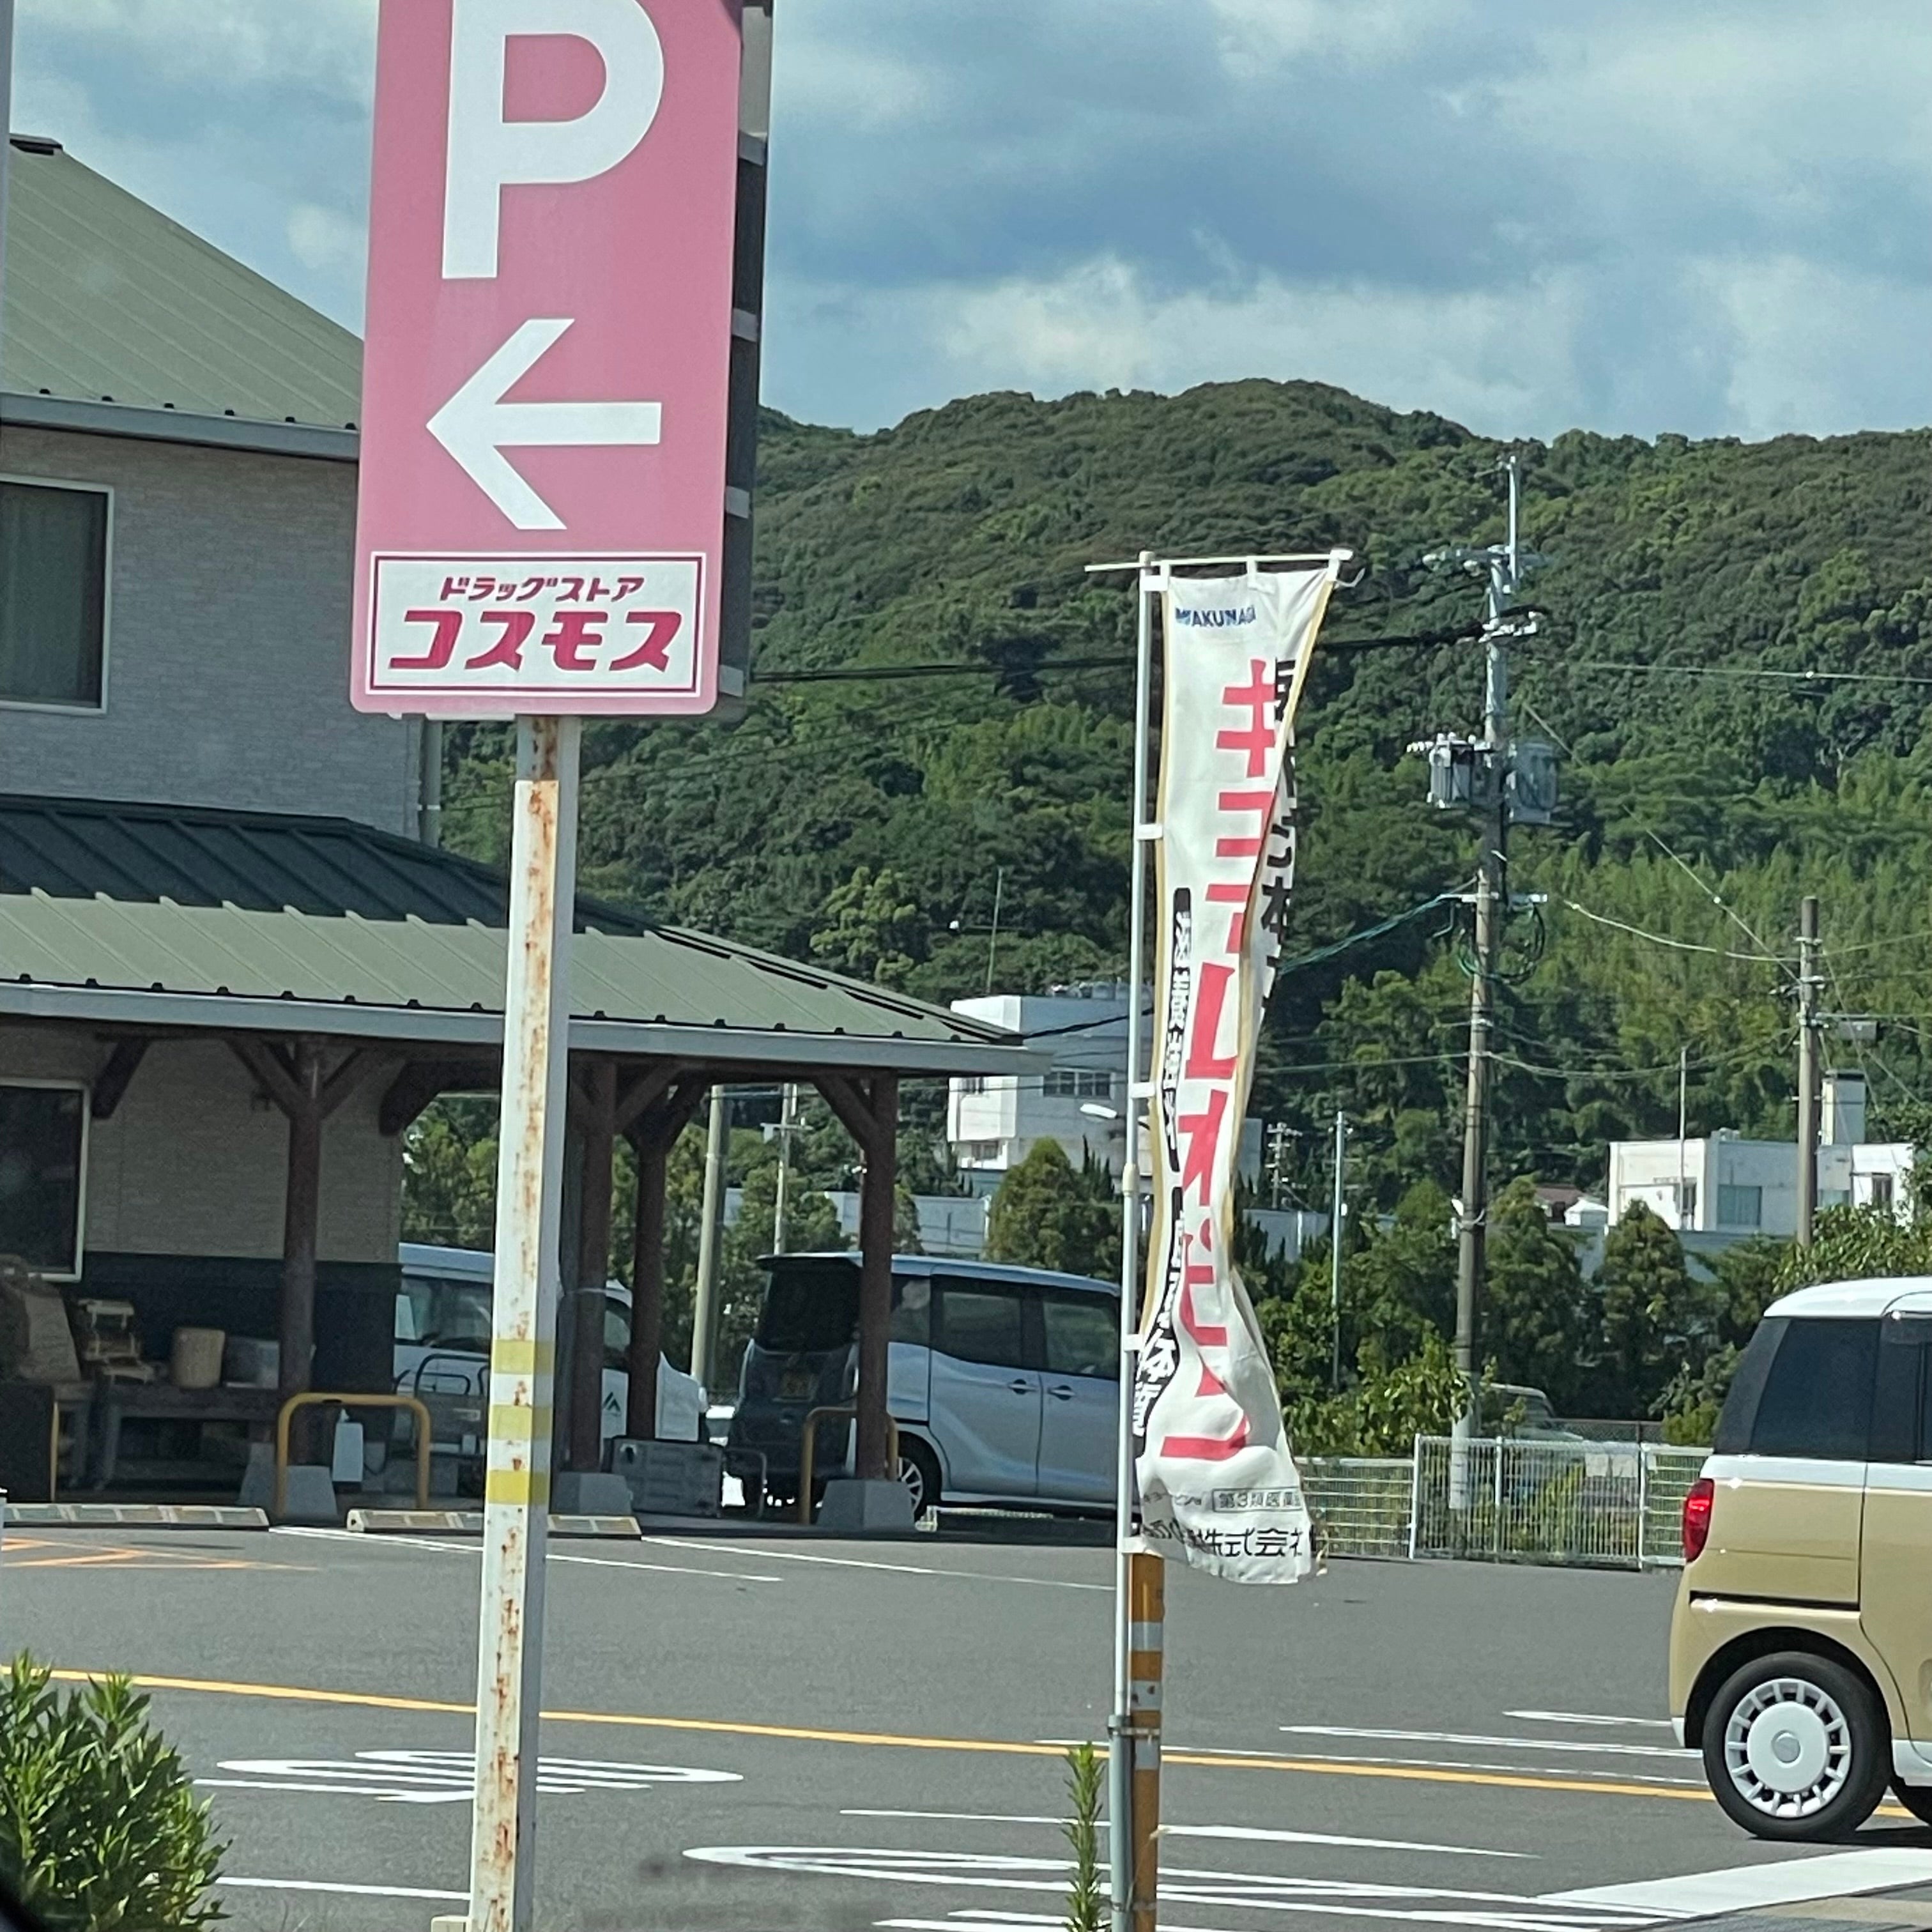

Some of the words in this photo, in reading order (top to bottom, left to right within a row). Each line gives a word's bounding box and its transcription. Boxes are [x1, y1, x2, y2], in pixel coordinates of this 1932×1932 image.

[442, 0, 664, 279] P
[440, 577, 644, 601] ドラッグストア
[388, 610, 682, 673] コスモス
